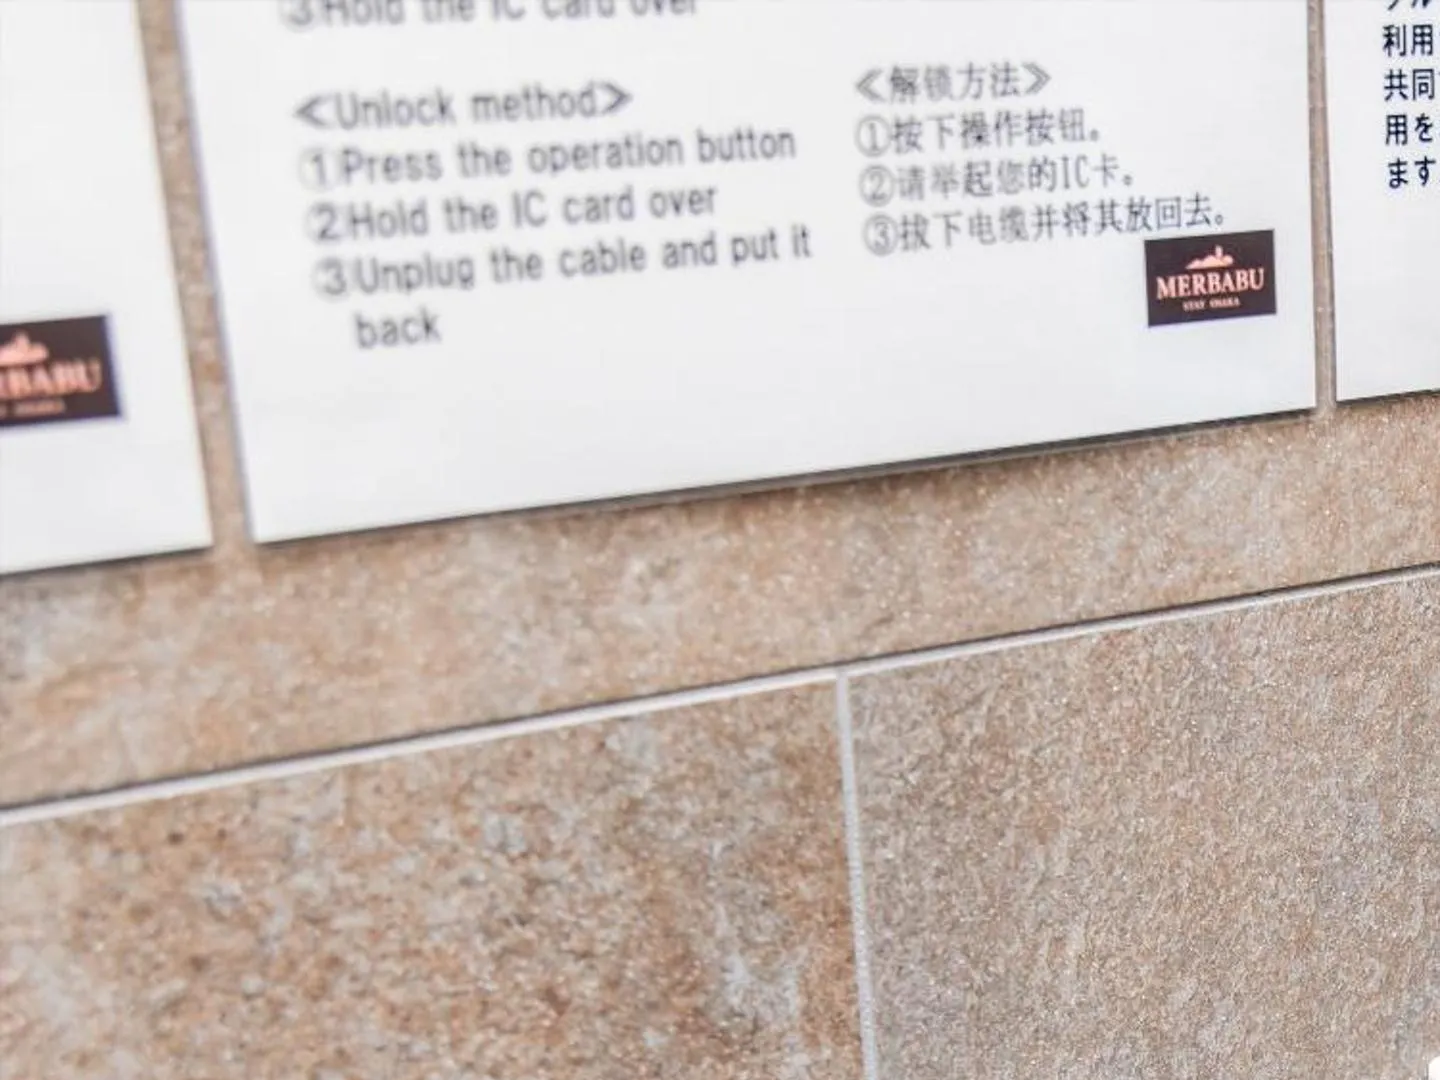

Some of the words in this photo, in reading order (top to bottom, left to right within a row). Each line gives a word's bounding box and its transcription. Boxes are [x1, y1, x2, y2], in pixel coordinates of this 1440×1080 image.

[457, 140, 511, 178] the
[527, 131, 684, 176] operation
[696, 124, 797, 164] button
[445, 195, 499, 233] the
[512, 189, 547, 227] IC
[562, 184, 635, 224] card
[649, 185, 717, 218] over
[489, 245, 544, 285] the
[559, 238, 647, 277] cable
[661, 231, 718, 270] and
[731, 227, 779, 264] put
[791, 223, 812, 259] it
[1156, 267, 1265, 300] MERBABU
[354, 305, 442, 350] back
